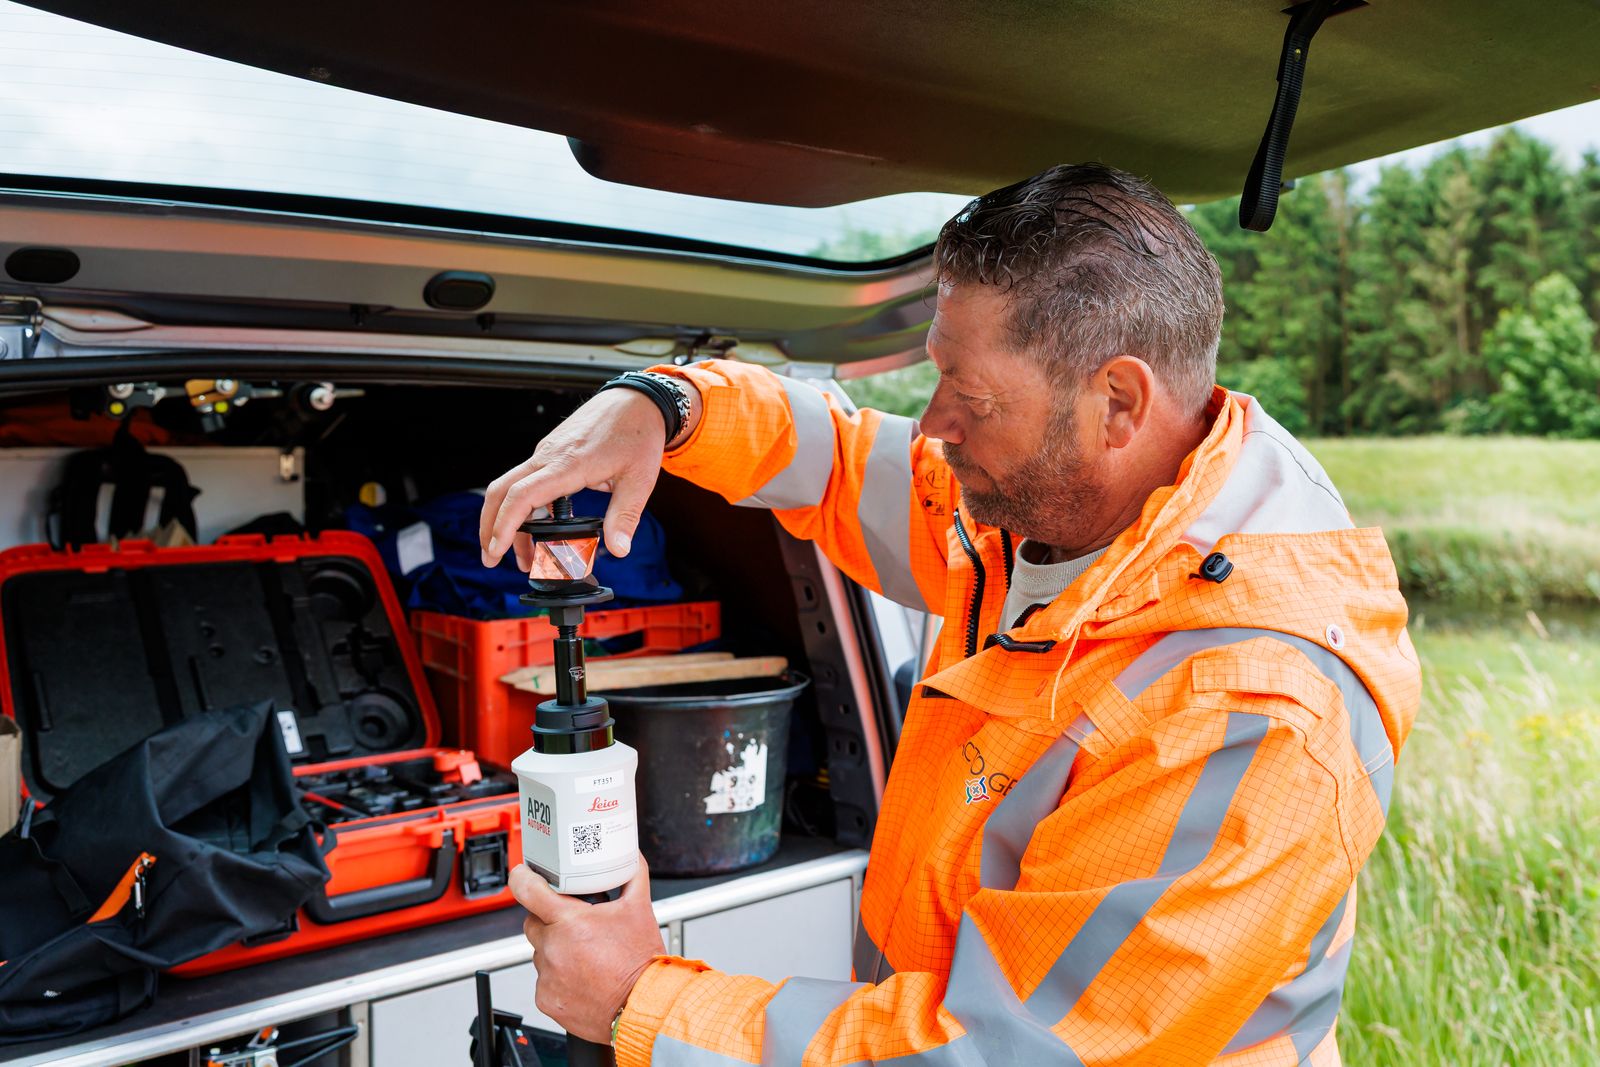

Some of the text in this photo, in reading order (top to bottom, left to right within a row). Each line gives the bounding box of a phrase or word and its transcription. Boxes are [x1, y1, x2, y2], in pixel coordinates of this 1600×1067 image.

[528, 797, 551, 826] AP20
[587, 797, 618, 812] Leica
[528, 818, 551, 837] AUTOPOLE
